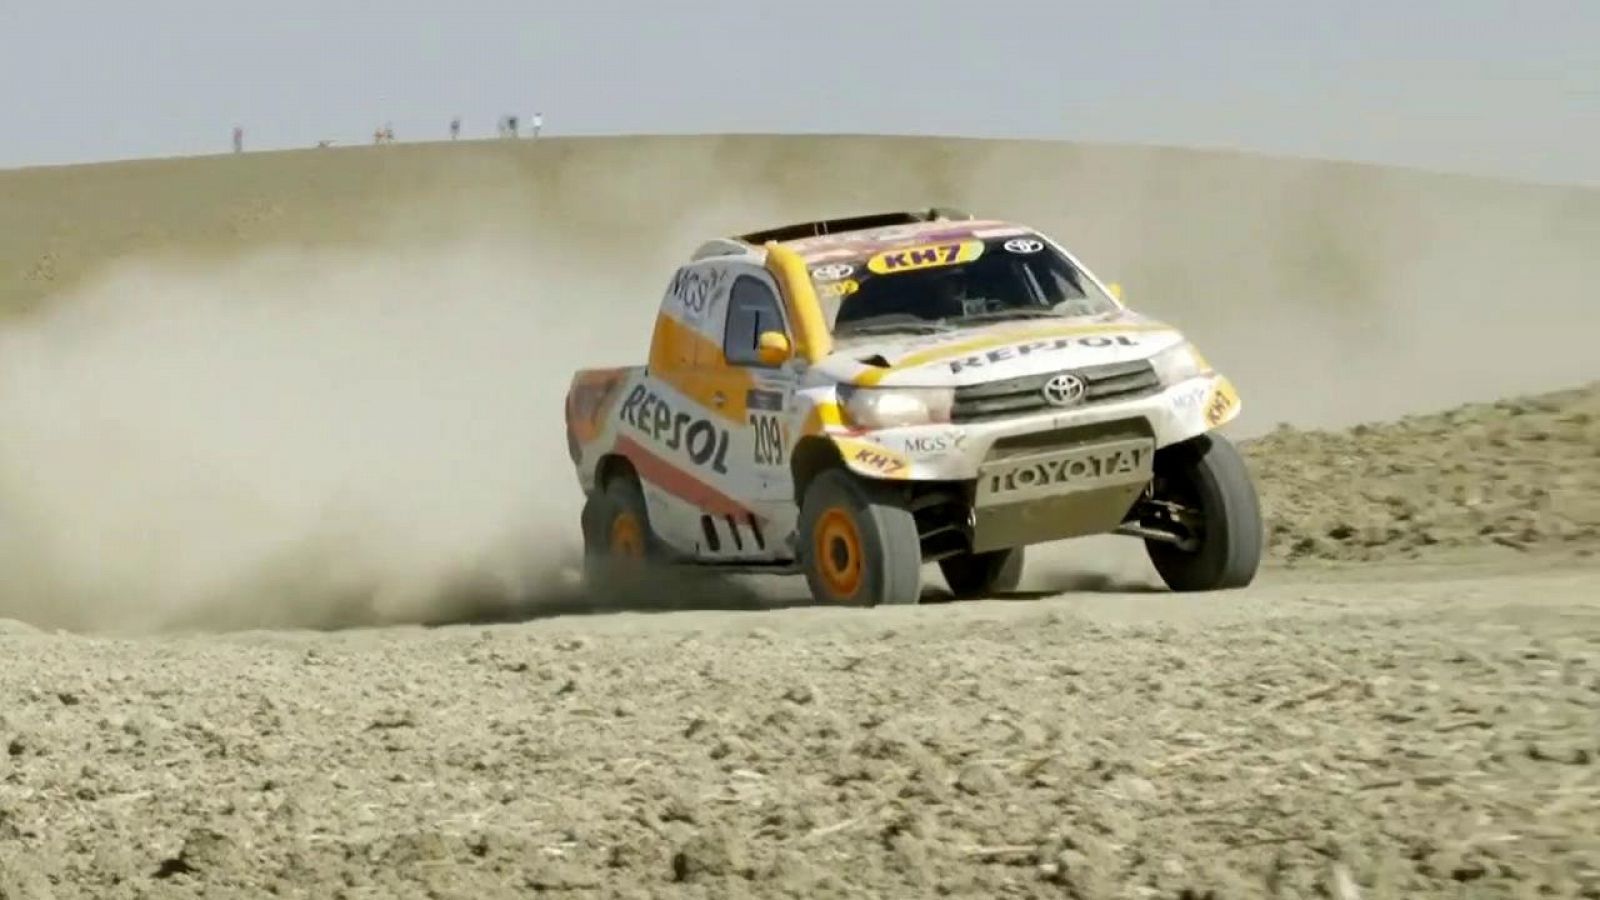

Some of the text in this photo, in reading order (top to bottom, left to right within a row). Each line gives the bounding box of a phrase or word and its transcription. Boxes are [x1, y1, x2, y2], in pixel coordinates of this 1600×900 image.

[950, 337, 1139, 372] REPSOL
[620, 384, 729, 474] REPSOL
[749, 415, 782, 465] 209
[905, 438, 946, 452] MGS
[989, 450, 1140, 493] TOYOTA
